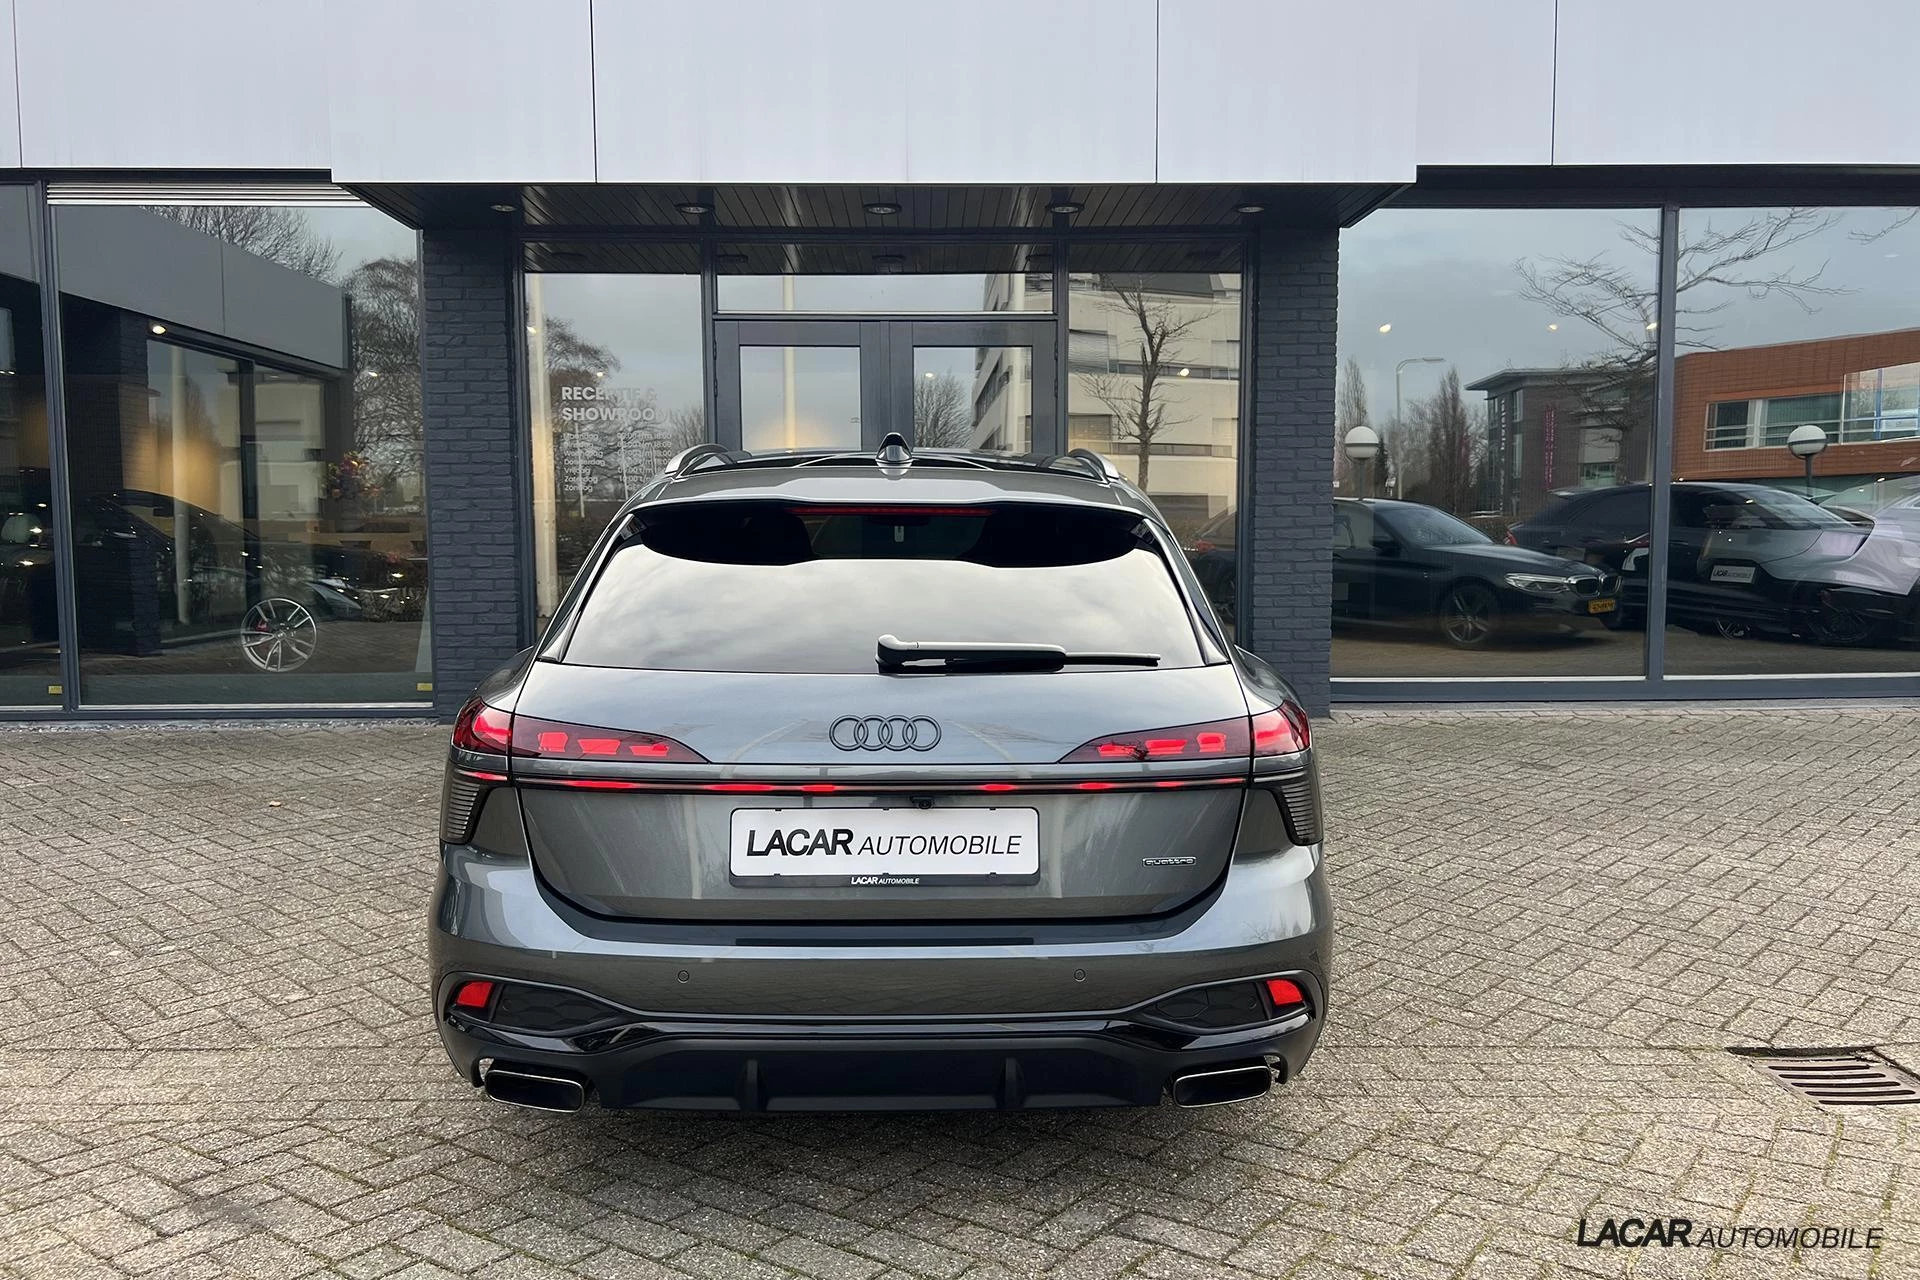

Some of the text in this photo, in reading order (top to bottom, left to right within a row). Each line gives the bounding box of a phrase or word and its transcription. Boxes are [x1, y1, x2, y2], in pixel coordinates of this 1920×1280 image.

[746, 829, 1023, 857] LACAR AUTOMOBILE
[1144, 858, 1195, 866] quattro
[851, 876, 920, 886] LACAR AUTOMOBILE
